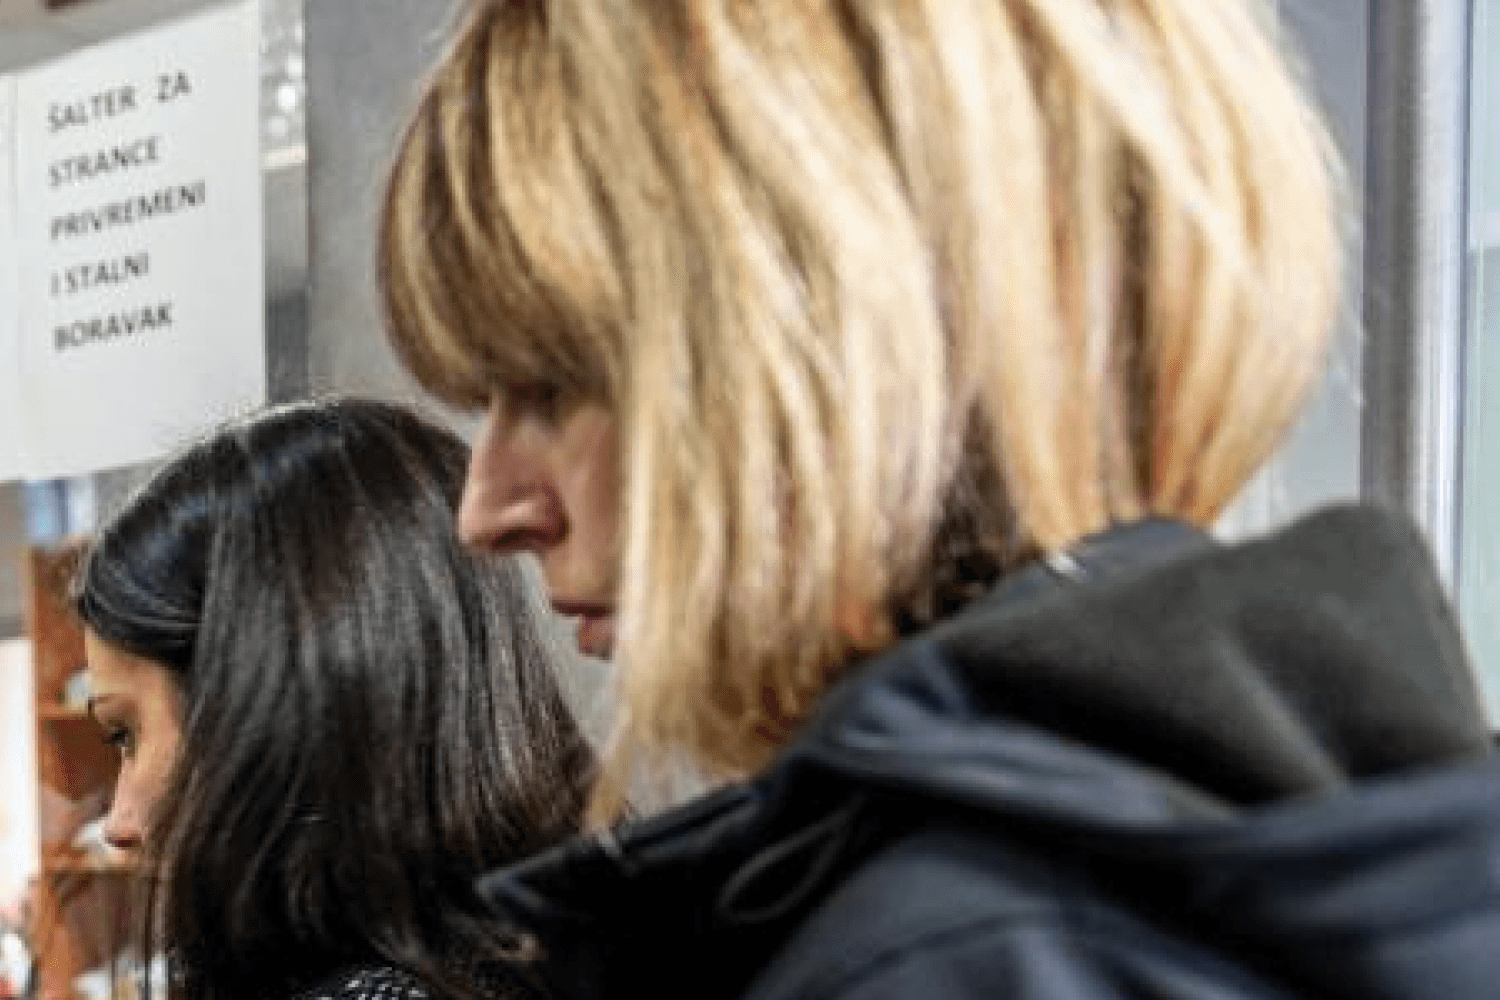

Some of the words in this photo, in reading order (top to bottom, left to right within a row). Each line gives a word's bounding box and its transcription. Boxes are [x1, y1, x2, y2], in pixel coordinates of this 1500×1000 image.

[157, 70, 192, 103] ZA
[49, 136, 159, 187] STRANCE
[51, 181, 206, 240] PRIVREMENI
[65, 253, 149, 294] STALNI
[54, 302, 177, 353] BORAVAK
